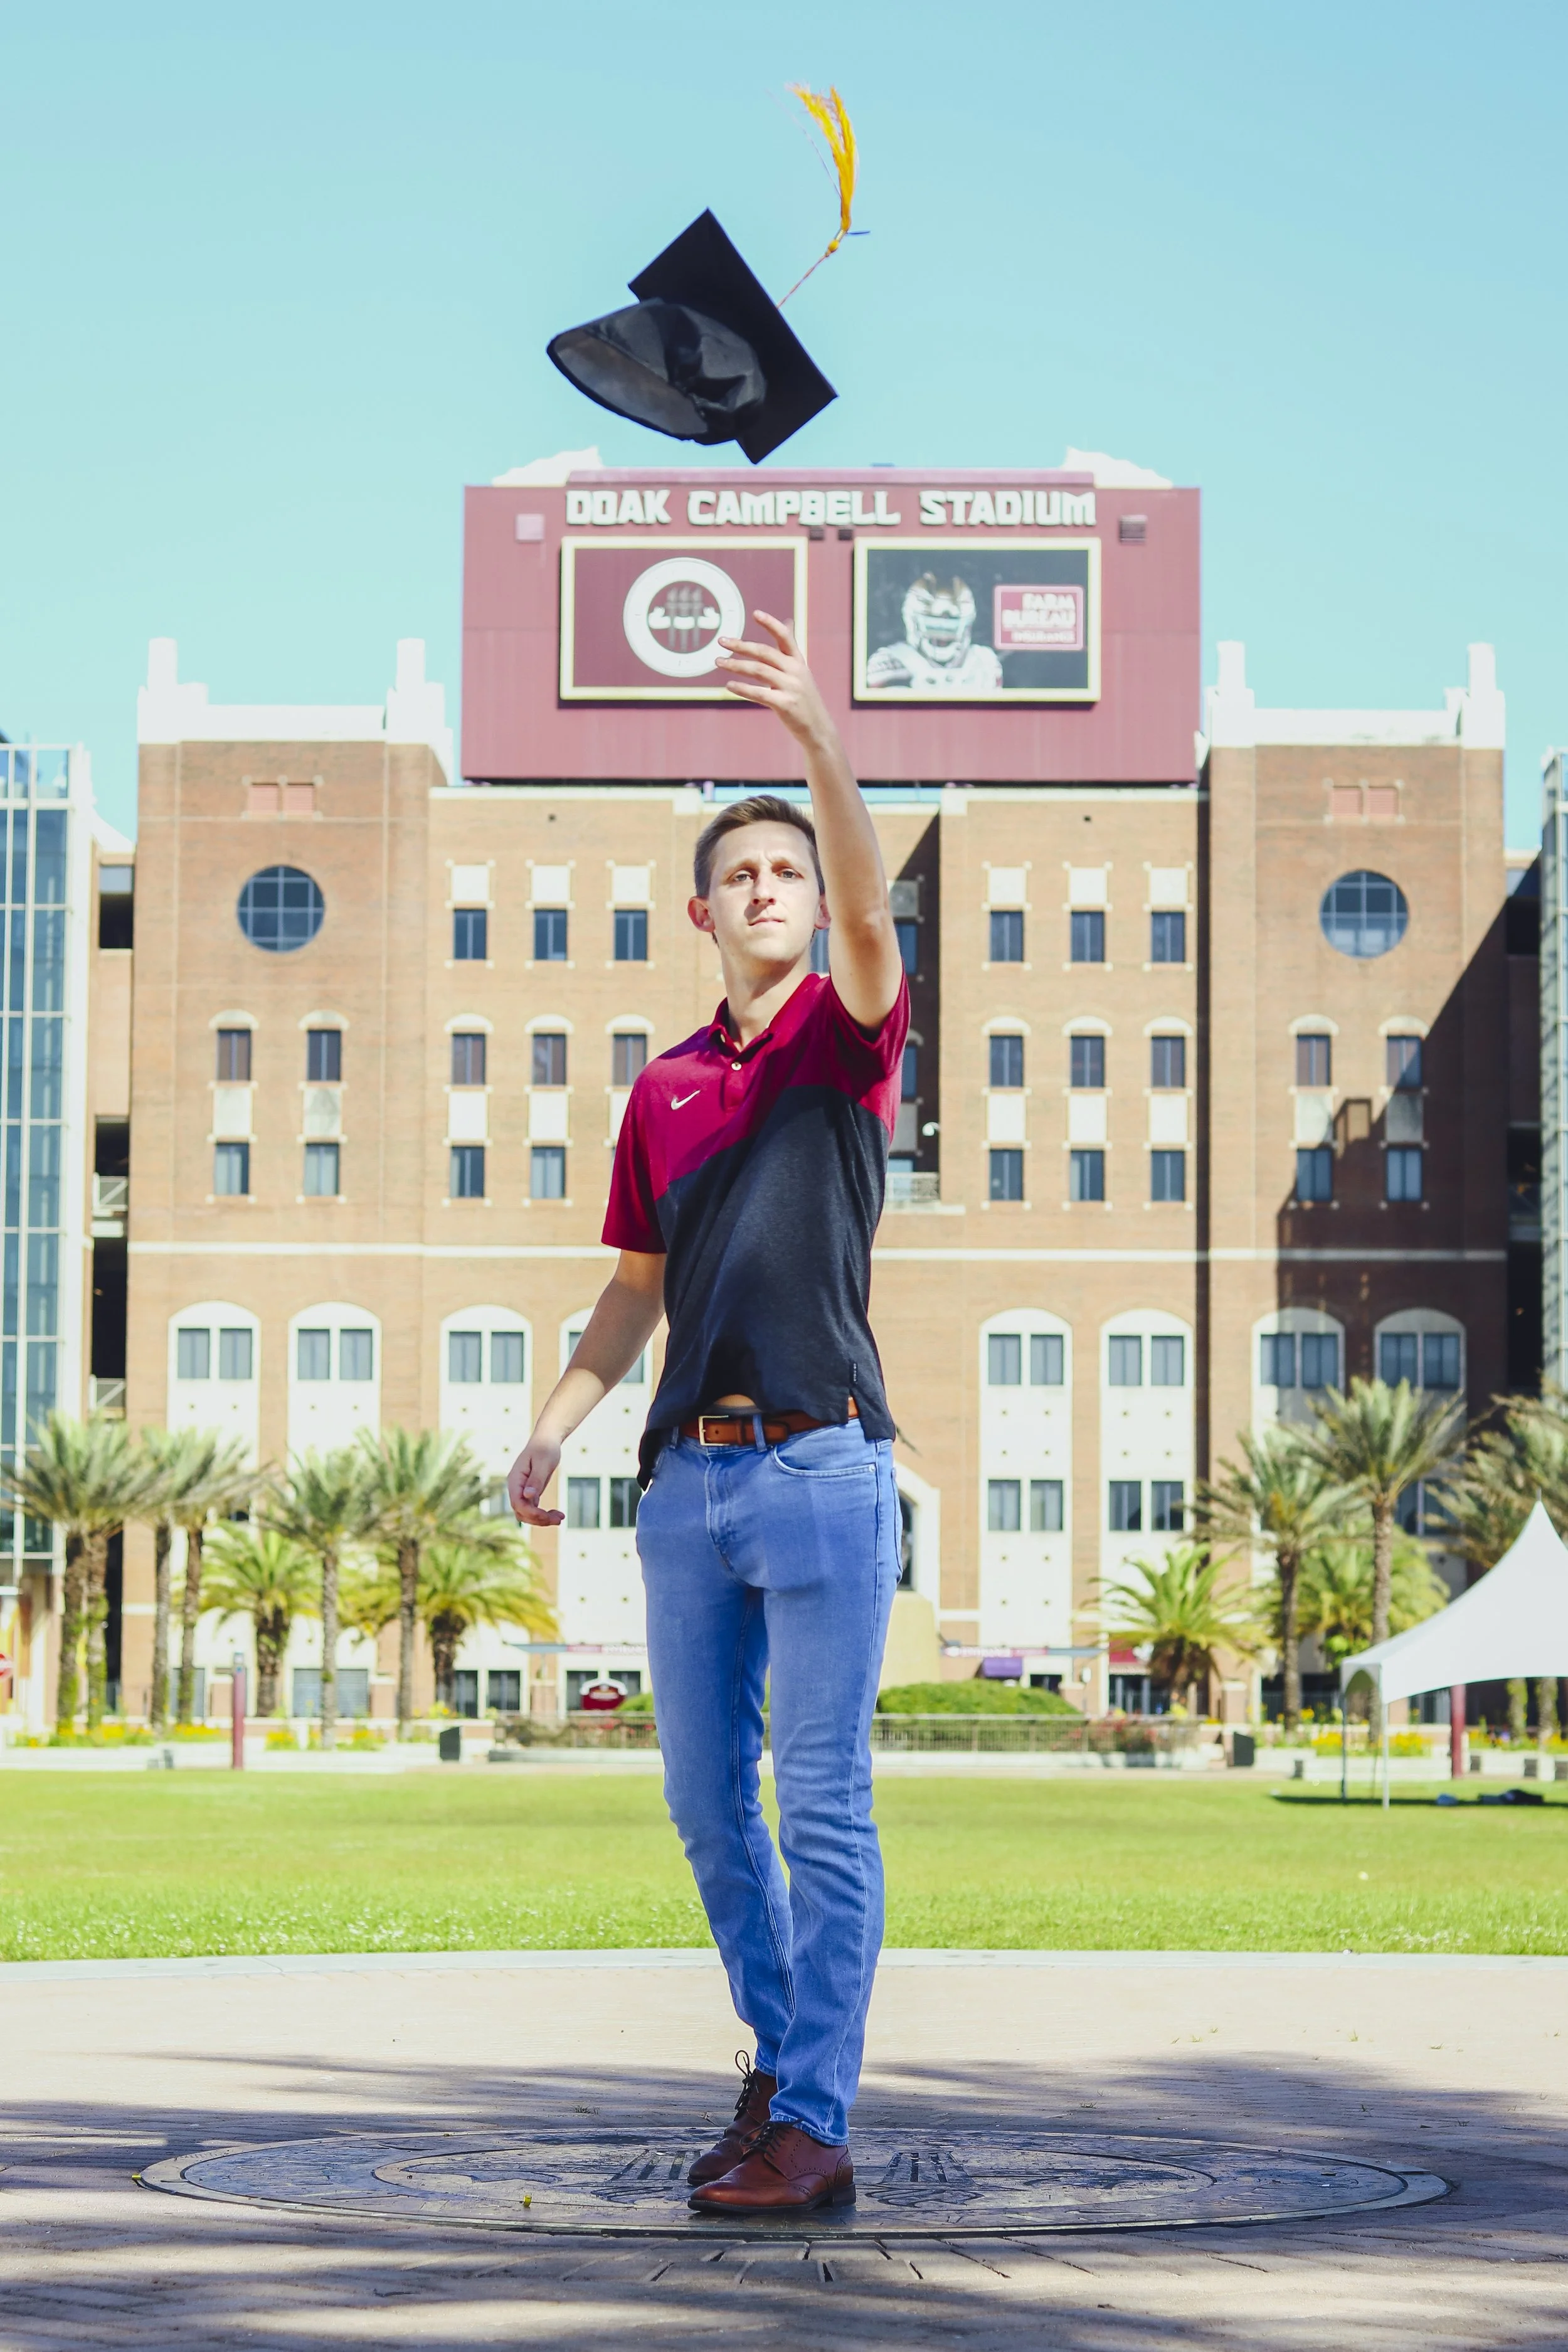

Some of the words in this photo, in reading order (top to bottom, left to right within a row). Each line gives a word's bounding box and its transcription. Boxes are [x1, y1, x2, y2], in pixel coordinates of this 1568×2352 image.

[566, 490, 672, 525] DOAK
[688, 490, 901, 526] CAMPBELL
[919, 490, 1096, 526] STADIUM
[1022, 593, 1076, 609] FARM
